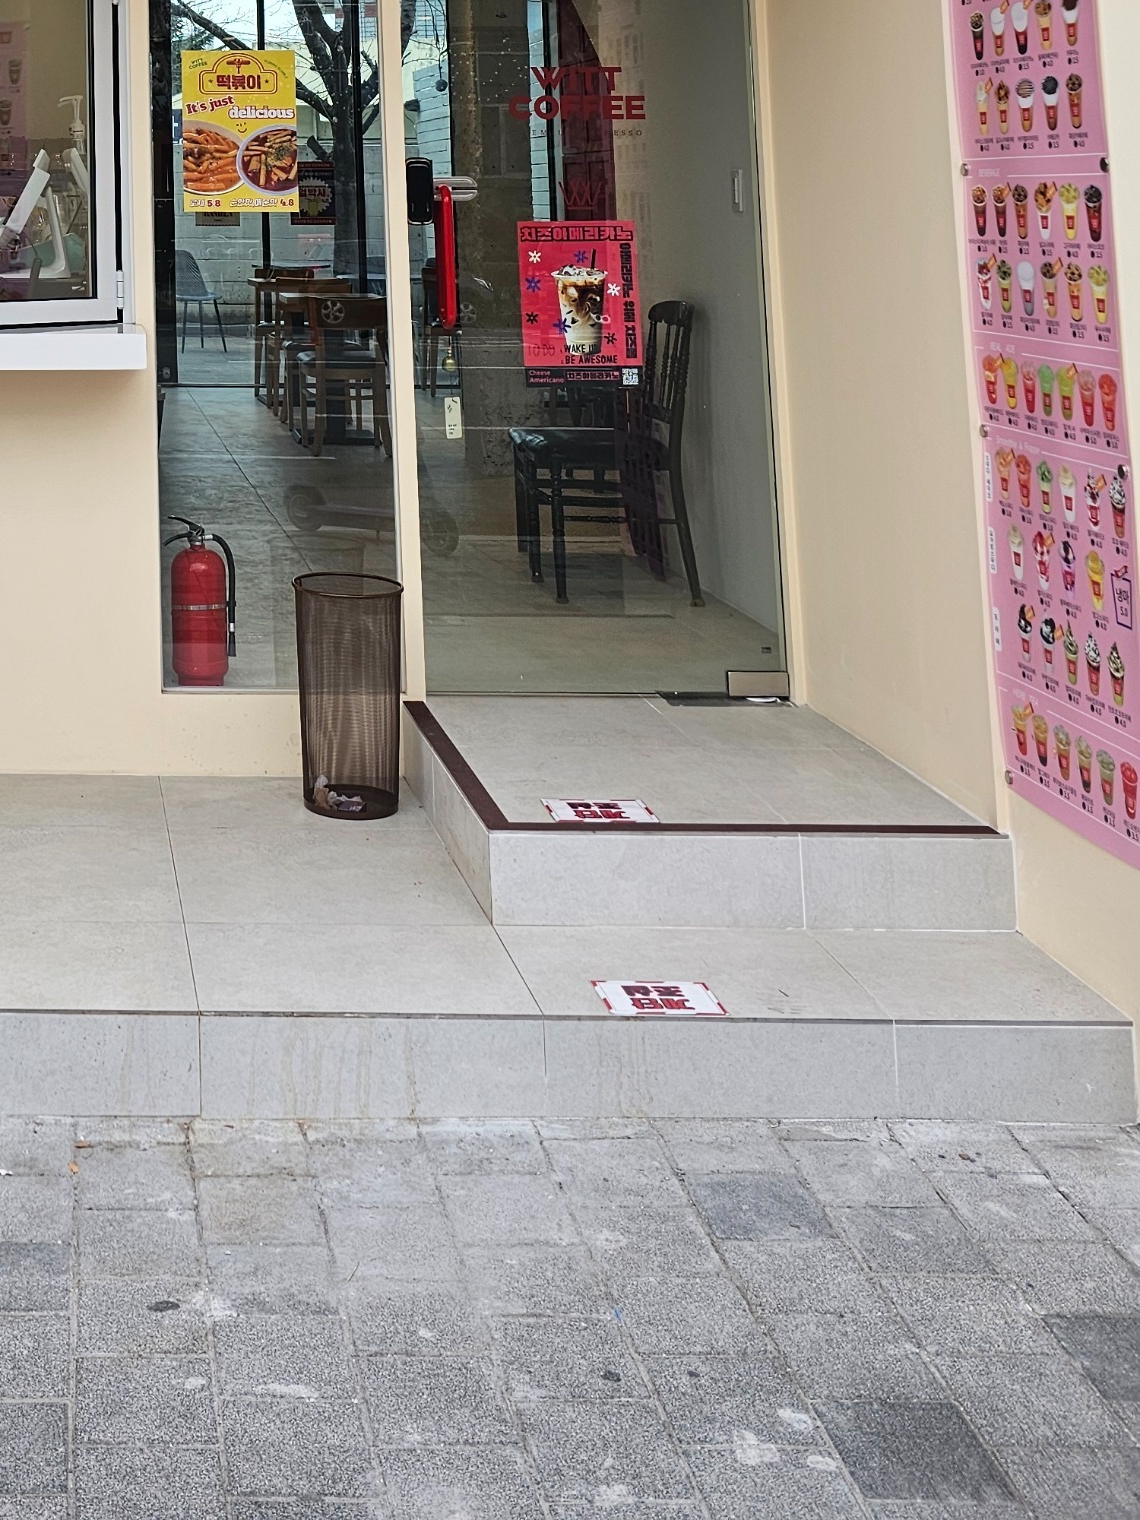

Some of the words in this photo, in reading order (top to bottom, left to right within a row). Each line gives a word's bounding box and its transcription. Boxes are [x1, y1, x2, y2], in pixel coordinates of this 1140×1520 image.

[216, 74, 261, 91] 떡볶이
[185, 100, 207, 115] It's
[208, 95, 234, 113] just
[228, 105, 295, 120] delicious
[520, 225, 634, 242] 치즈아메리카노
[564, 344, 586, 353] WAKE
[565, 355, 576, 365] BE
[579, 355, 618, 365] AWESOME
